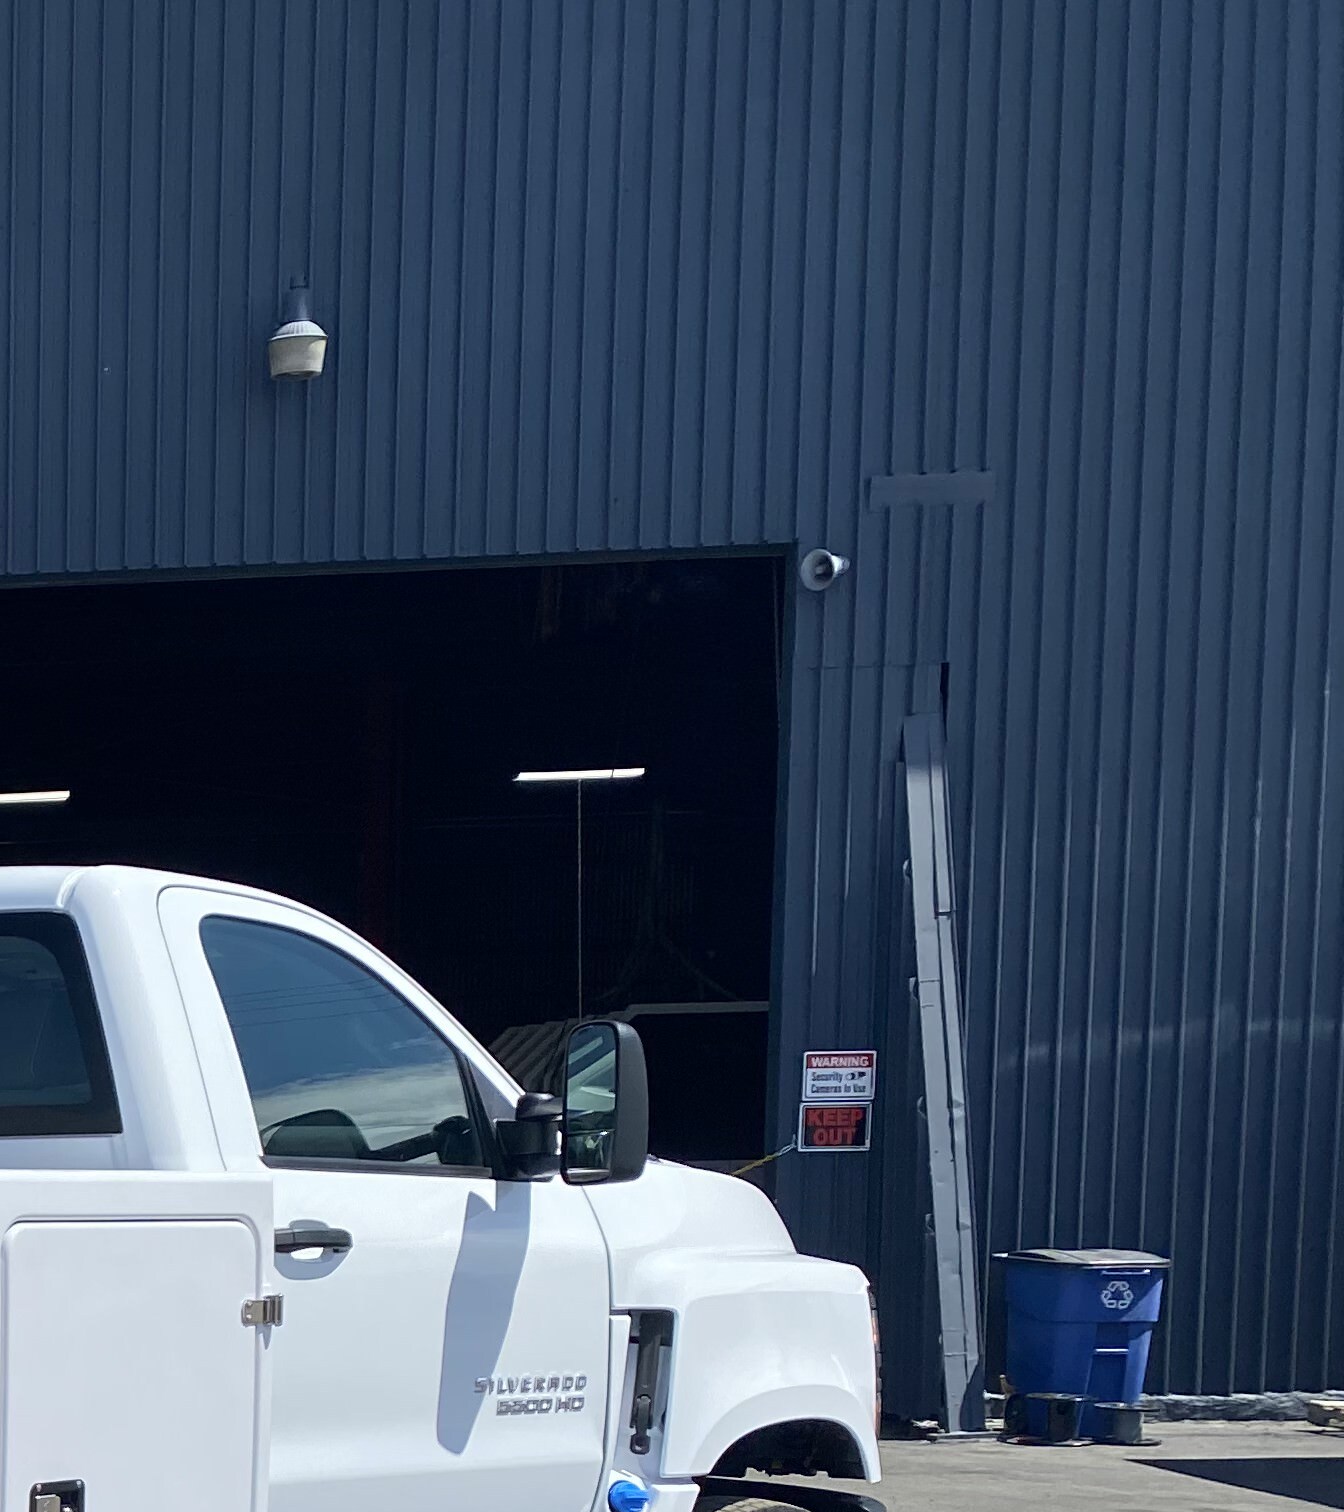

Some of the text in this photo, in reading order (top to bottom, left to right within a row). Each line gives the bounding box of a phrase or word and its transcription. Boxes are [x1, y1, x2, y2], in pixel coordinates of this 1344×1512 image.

[811, 1056, 870, 1068] WARNING
[811, 1071, 844, 1083] Security
[811, 1084, 842, 1094] Cameras
[806, 1108, 864, 1127] KEEP
[813, 1127, 857, 1146] OUT
[473, 1375, 588, 1396] SILVERADO
[555, 1395, 586, 1414] HD
